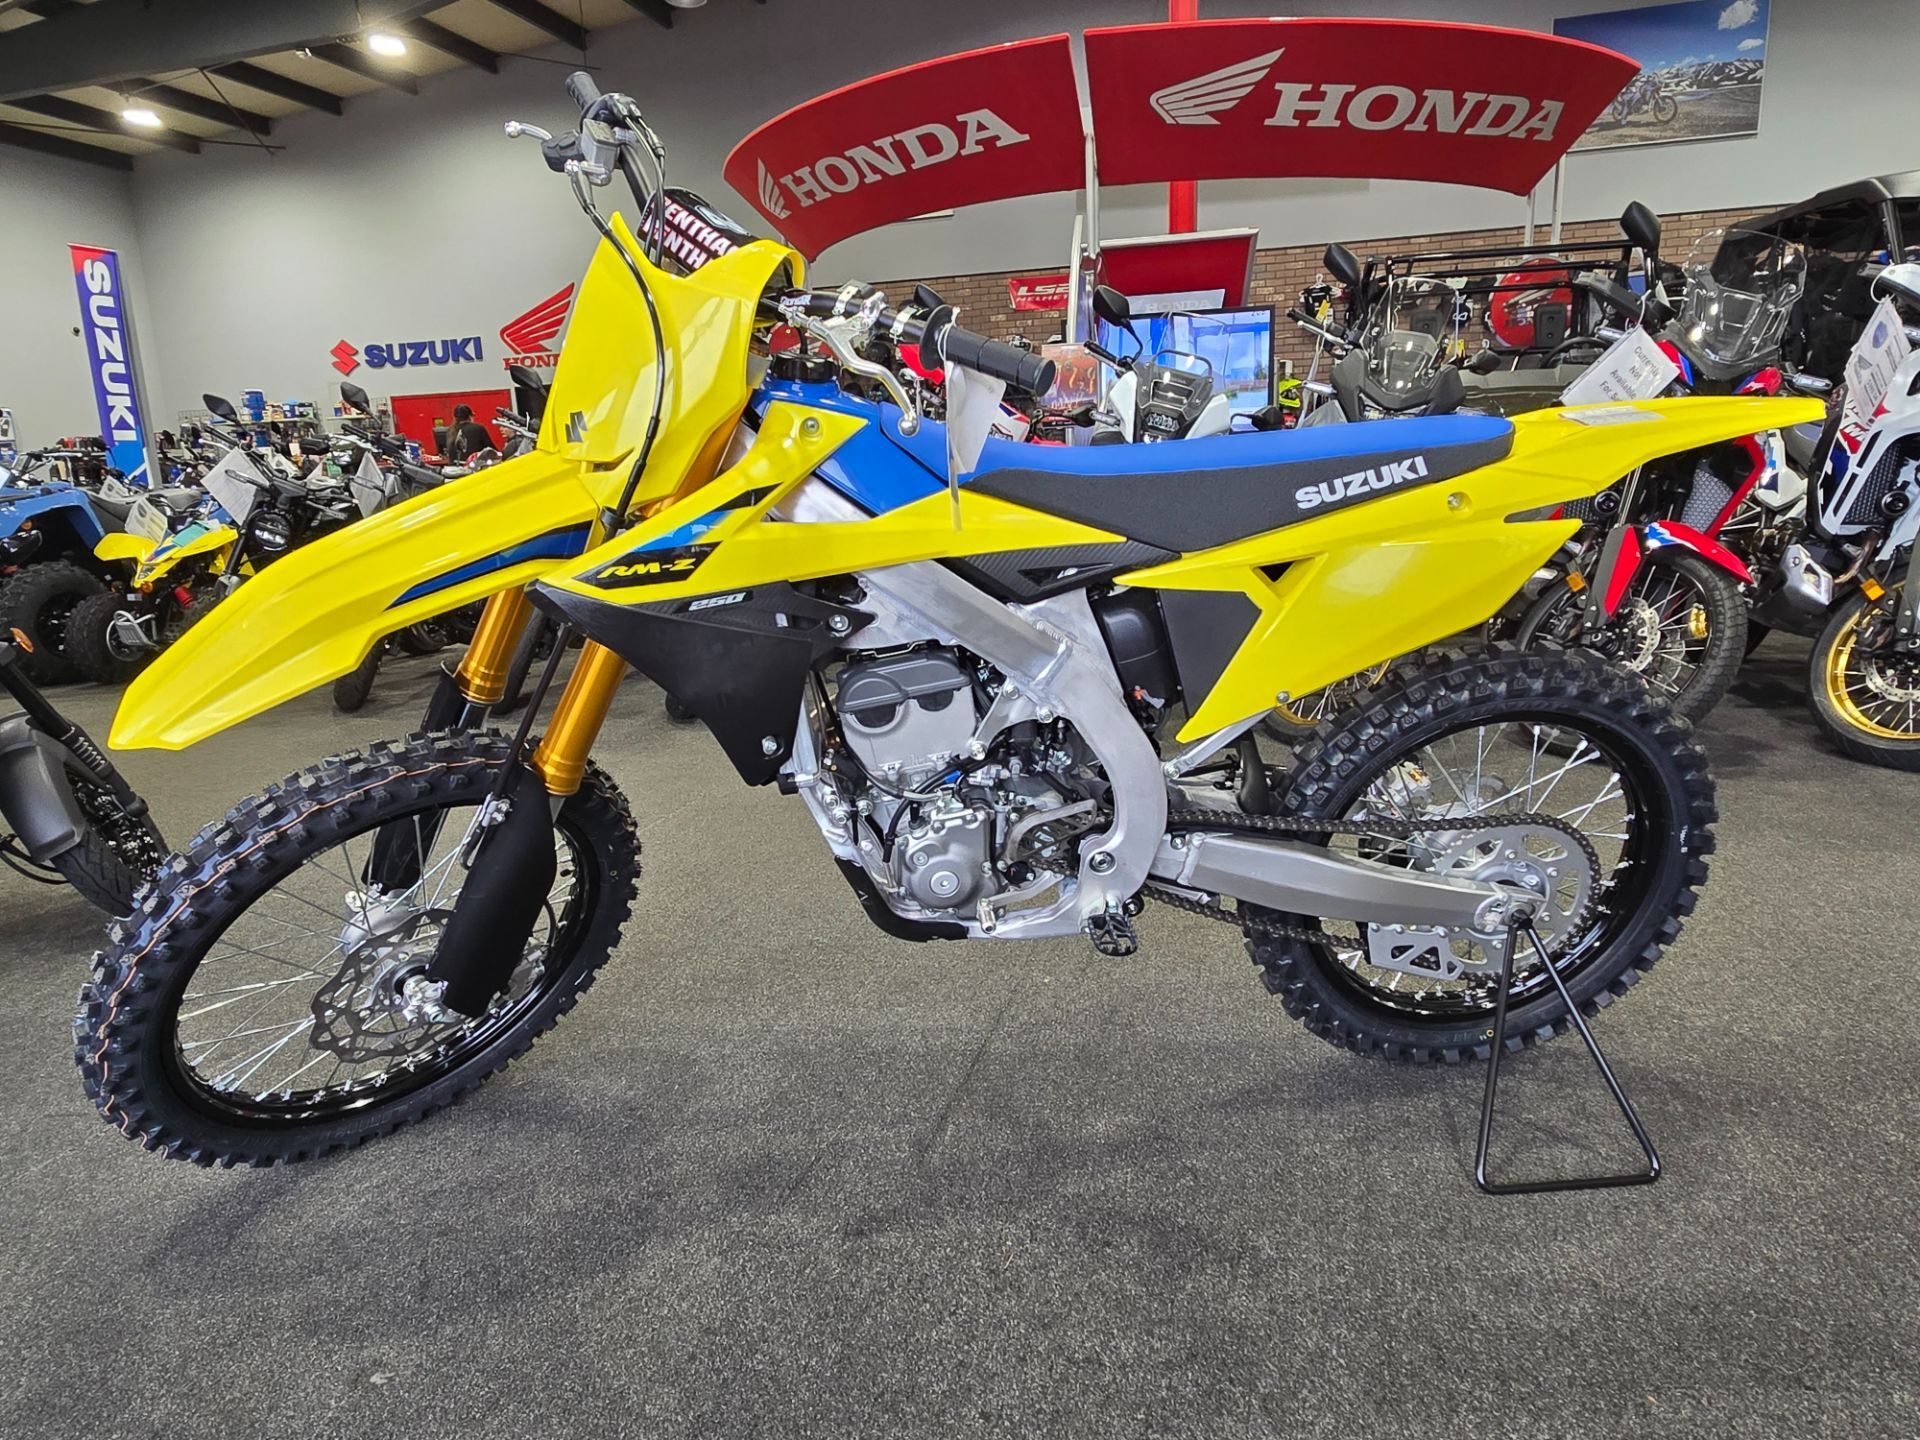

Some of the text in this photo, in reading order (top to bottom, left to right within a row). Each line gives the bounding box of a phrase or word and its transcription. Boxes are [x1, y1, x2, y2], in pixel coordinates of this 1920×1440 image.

[1264, 82, 1564, 141] HONDA
[779, 108, 1030, 208] HONDA
[1145, 299, 1211, 312] HONDA
[83, 259, 138, 442] SUZUKI
[364, 336, 483, 368] SUZUKI
[1610, 369, 1637, 400] Available
[1628, 365, 1642, 380] Not
[1295, 456, 1429, 509] SUZUKI
[596, 558, 696, 579] RM-Z
[688, 592, 747, 611] 250
